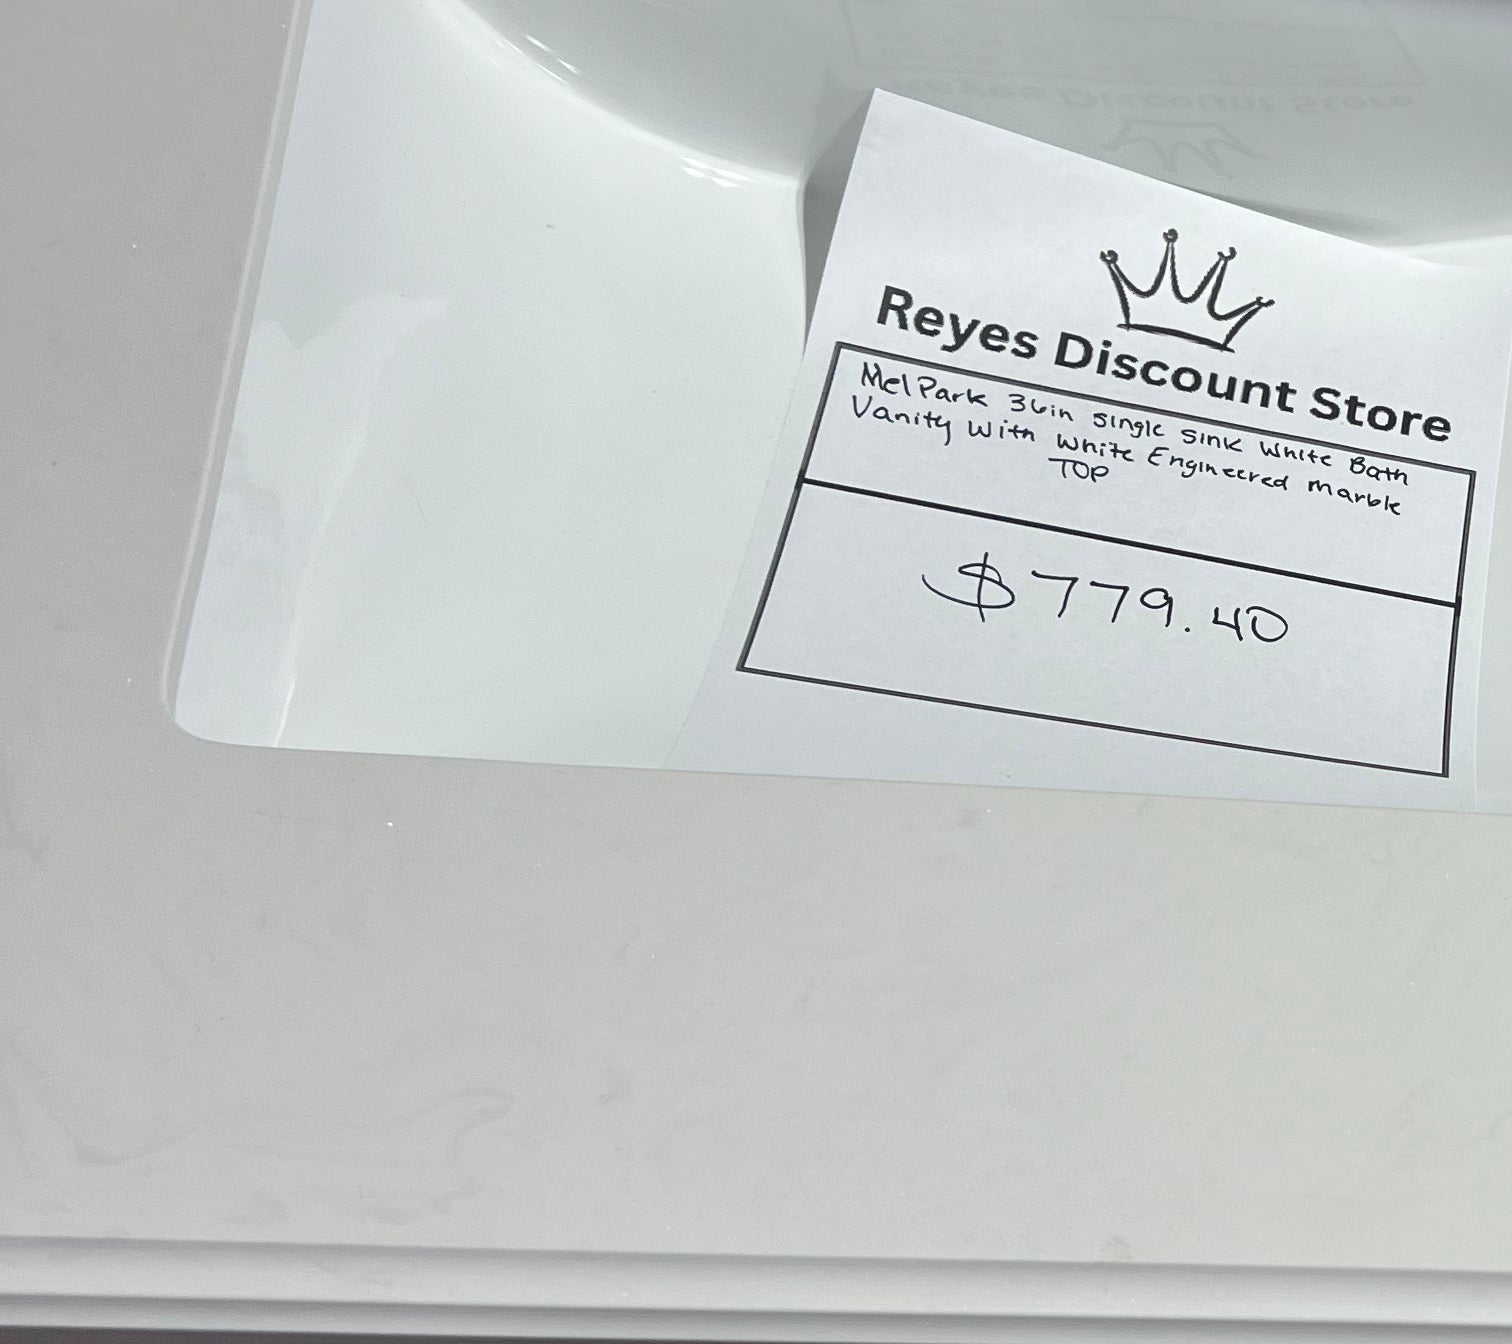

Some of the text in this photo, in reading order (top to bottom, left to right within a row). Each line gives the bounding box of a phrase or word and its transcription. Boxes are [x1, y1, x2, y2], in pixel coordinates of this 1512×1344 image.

[876, 284, 1452, 443] Reyes Discount Store
[851, 394, 952, 447] Vanity
[1056, 432, 1135, 463] White
[1147, 445, 1289, 493] Engineered
[1008, 393, 1075, 423] 36in
[1260, 440, 1333, 467] White
[1348, 456, 1410, 487] Bath
[921, 552, 1289, 642] $779.40
